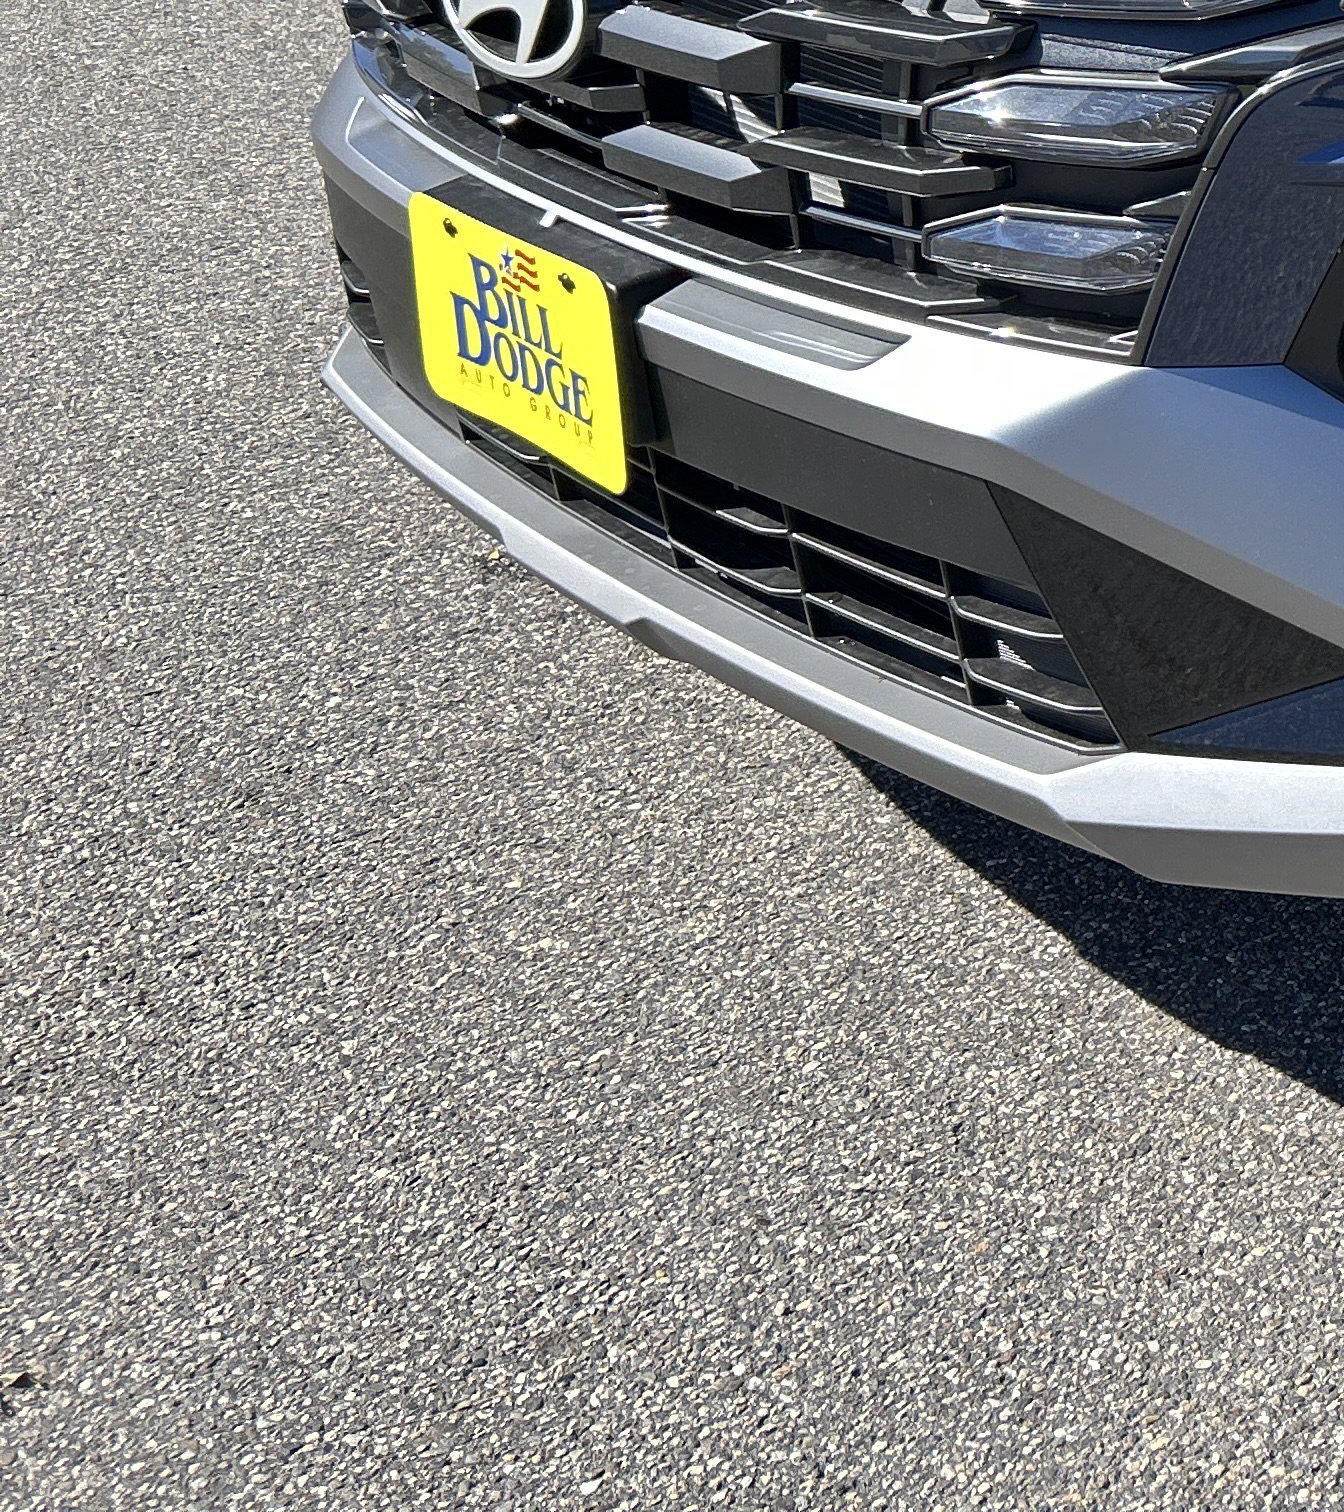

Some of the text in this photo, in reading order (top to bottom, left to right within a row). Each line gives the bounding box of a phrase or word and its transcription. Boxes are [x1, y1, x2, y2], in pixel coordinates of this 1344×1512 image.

[449, 291, 594, 427] DODGE
[467, 252, 564, 361] BILL
[459, 363, 594, 446] AUTO GROUP
